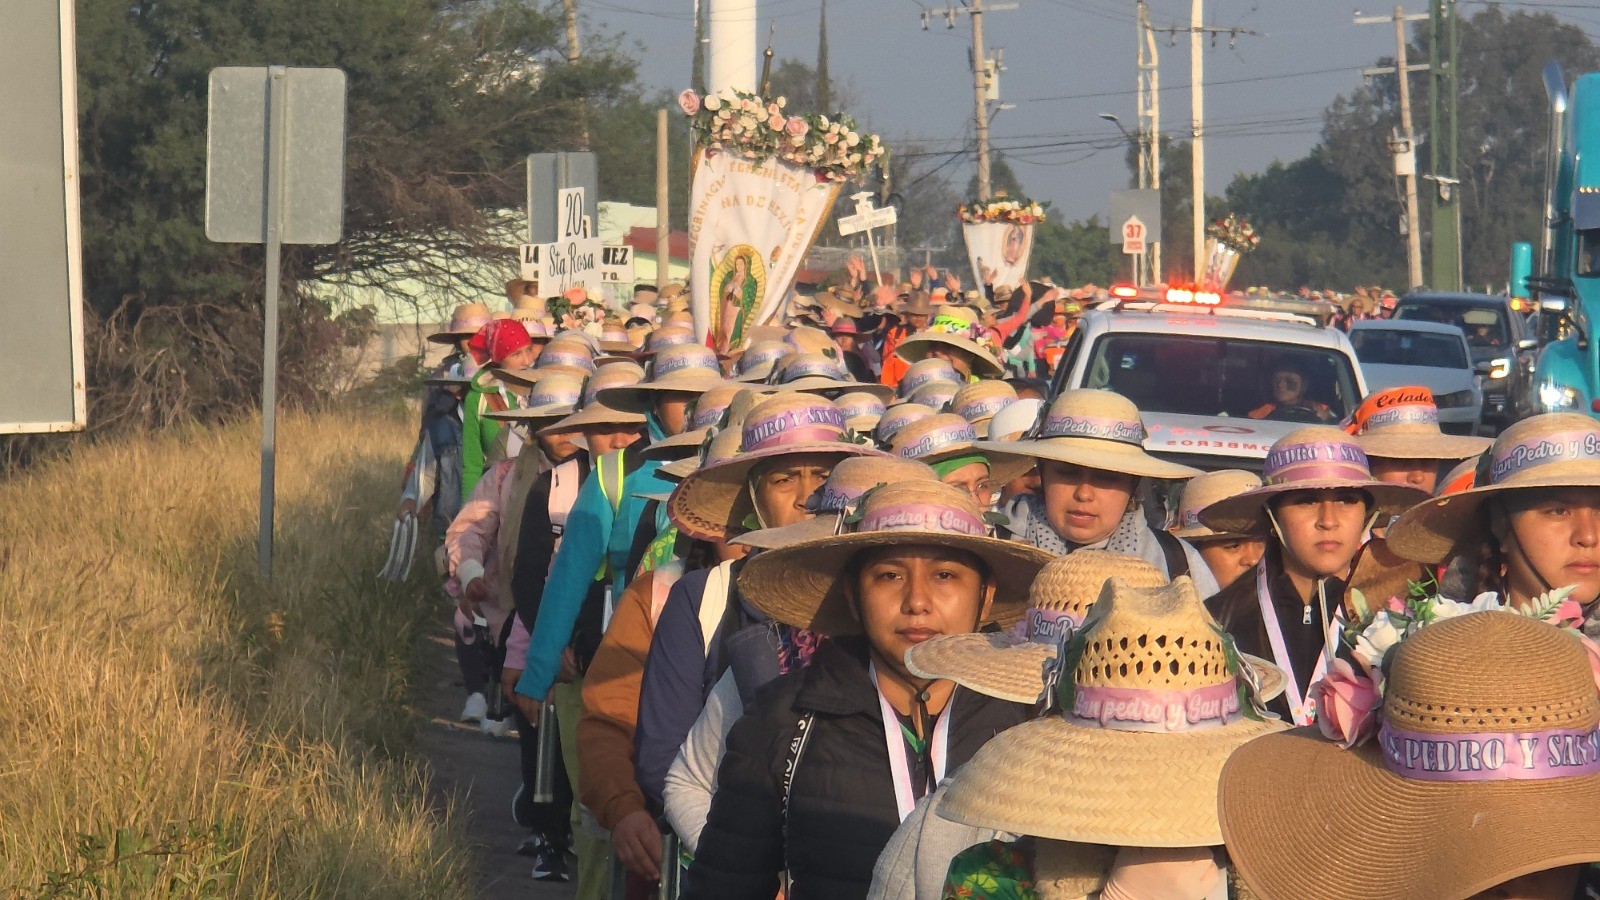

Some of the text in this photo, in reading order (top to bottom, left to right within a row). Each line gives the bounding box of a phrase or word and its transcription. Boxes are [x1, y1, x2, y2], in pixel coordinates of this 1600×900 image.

[565, 191, 583, 238] 20
[745, 195, 766, 209] DE
[1126, 223, 1142, 239] 37
[549, 241, 595, 278] Sta Rosa
[1376, 392, 1433, 408] Celado
[791, 411, 803, 427] Y
[1060, 415, 1098, 435] Pedro
[1100, 424, 1111, 438] y
[1112, 421, 1133, 439] San
[1387, 407, 1420, 423] Pedro
[901, 446, 922, 461] San
[920, 430, 959, 452] Pedro
[959, 428, 968, 442] y
[1324, 445, 1335, 461] Y
[1510, 440, 1564, 468] Pedro
[1567, 439, 1580, 460] y
[1032, 610, 1056, 638] San
[1100, 697, 1164, 728] pedro
[1164, 702, 1184, 732] y
[1184, 693, 1221, 724] San
[1404, 738, 1506, 772] PEDRO
[1517, 737, 1539, 770] Y
